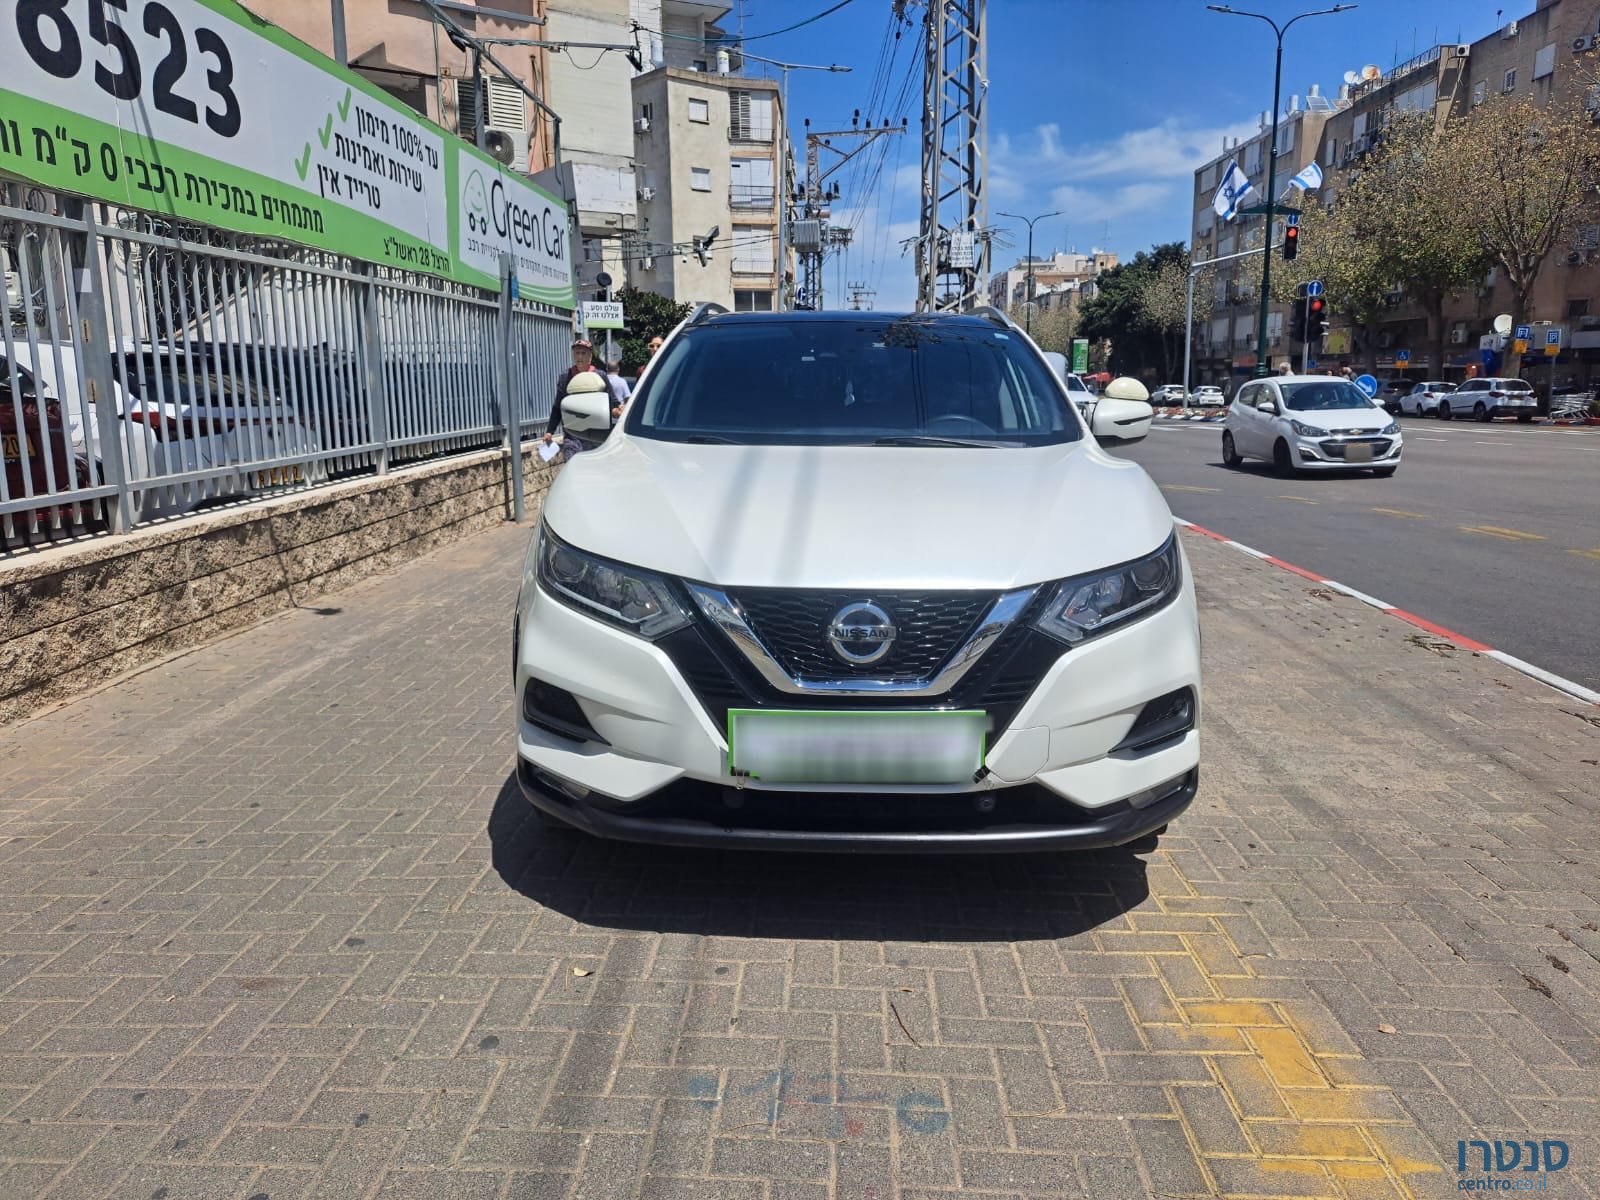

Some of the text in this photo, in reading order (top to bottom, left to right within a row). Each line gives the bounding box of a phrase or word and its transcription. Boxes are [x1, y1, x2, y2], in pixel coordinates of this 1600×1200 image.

[355, 105, 439, 170] עד 100% מימון
[124, 155, 179, 198] רכבי
[334, 132, 422, 192] שירות ואמינות
[183, 172, 258, 217] במכירת
[317, 163, 381, 209] טרייד אין
[261, 194, 325, 233] מתמחים
[491, 179, 564, 261] Green Car
[418, 245, 430, 267] 28
[430, 248, 450, 272] הרצל
[833, 627, 889, 639] NISSAN
